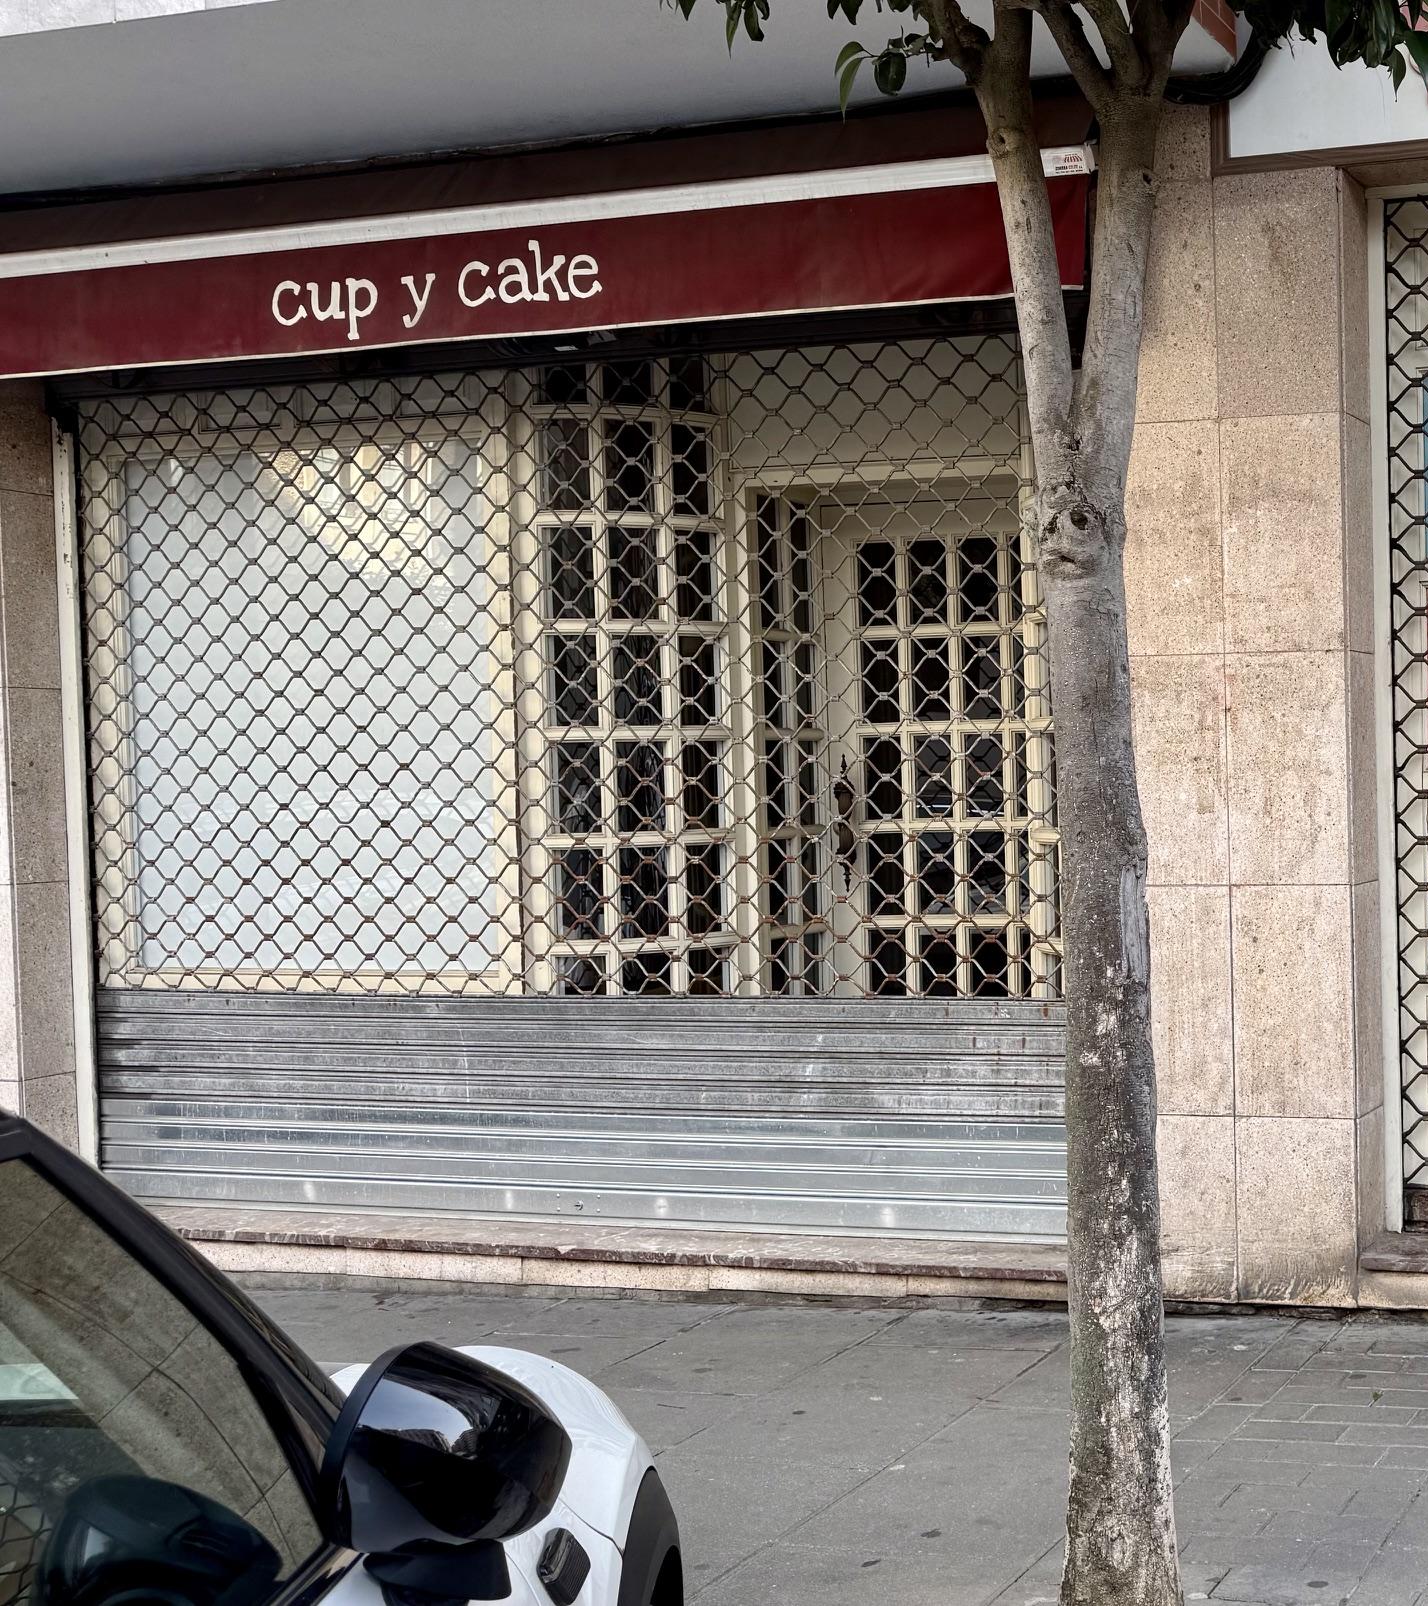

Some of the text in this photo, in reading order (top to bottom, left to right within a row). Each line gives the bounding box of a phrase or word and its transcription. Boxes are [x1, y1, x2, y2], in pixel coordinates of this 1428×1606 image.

[272, 239, 603, 341] cup y cake
